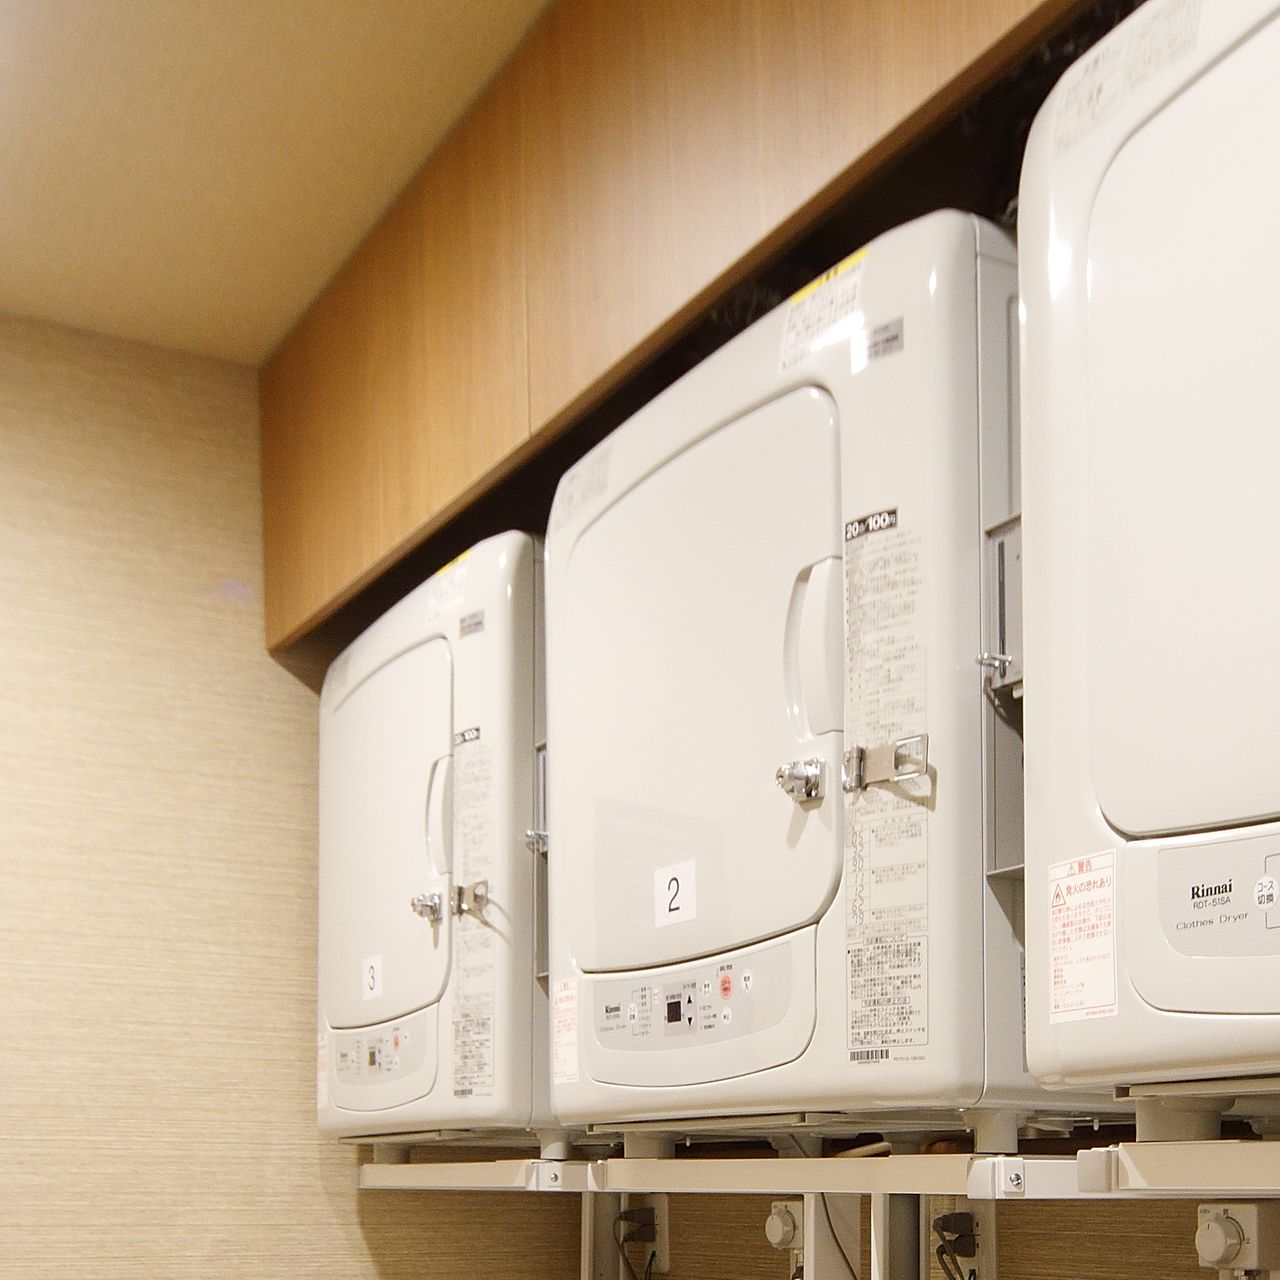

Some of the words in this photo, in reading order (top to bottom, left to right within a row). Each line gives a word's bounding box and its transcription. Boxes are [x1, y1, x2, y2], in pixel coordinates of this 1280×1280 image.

[667, 876, 681, 913] 2
[1065, 875, 1112, 897] 発火の恐れあり
[1191, 879, 1233, 900] Rinnai
[1257, 881, 1274, 892] コース
[1193, 896, 1231, 910] RDT-51SA
[1176, 917, 1214, 931] Clothes
[1219, 912, 1249, 926] Dryer
[368, 964, 376, 991] 3
